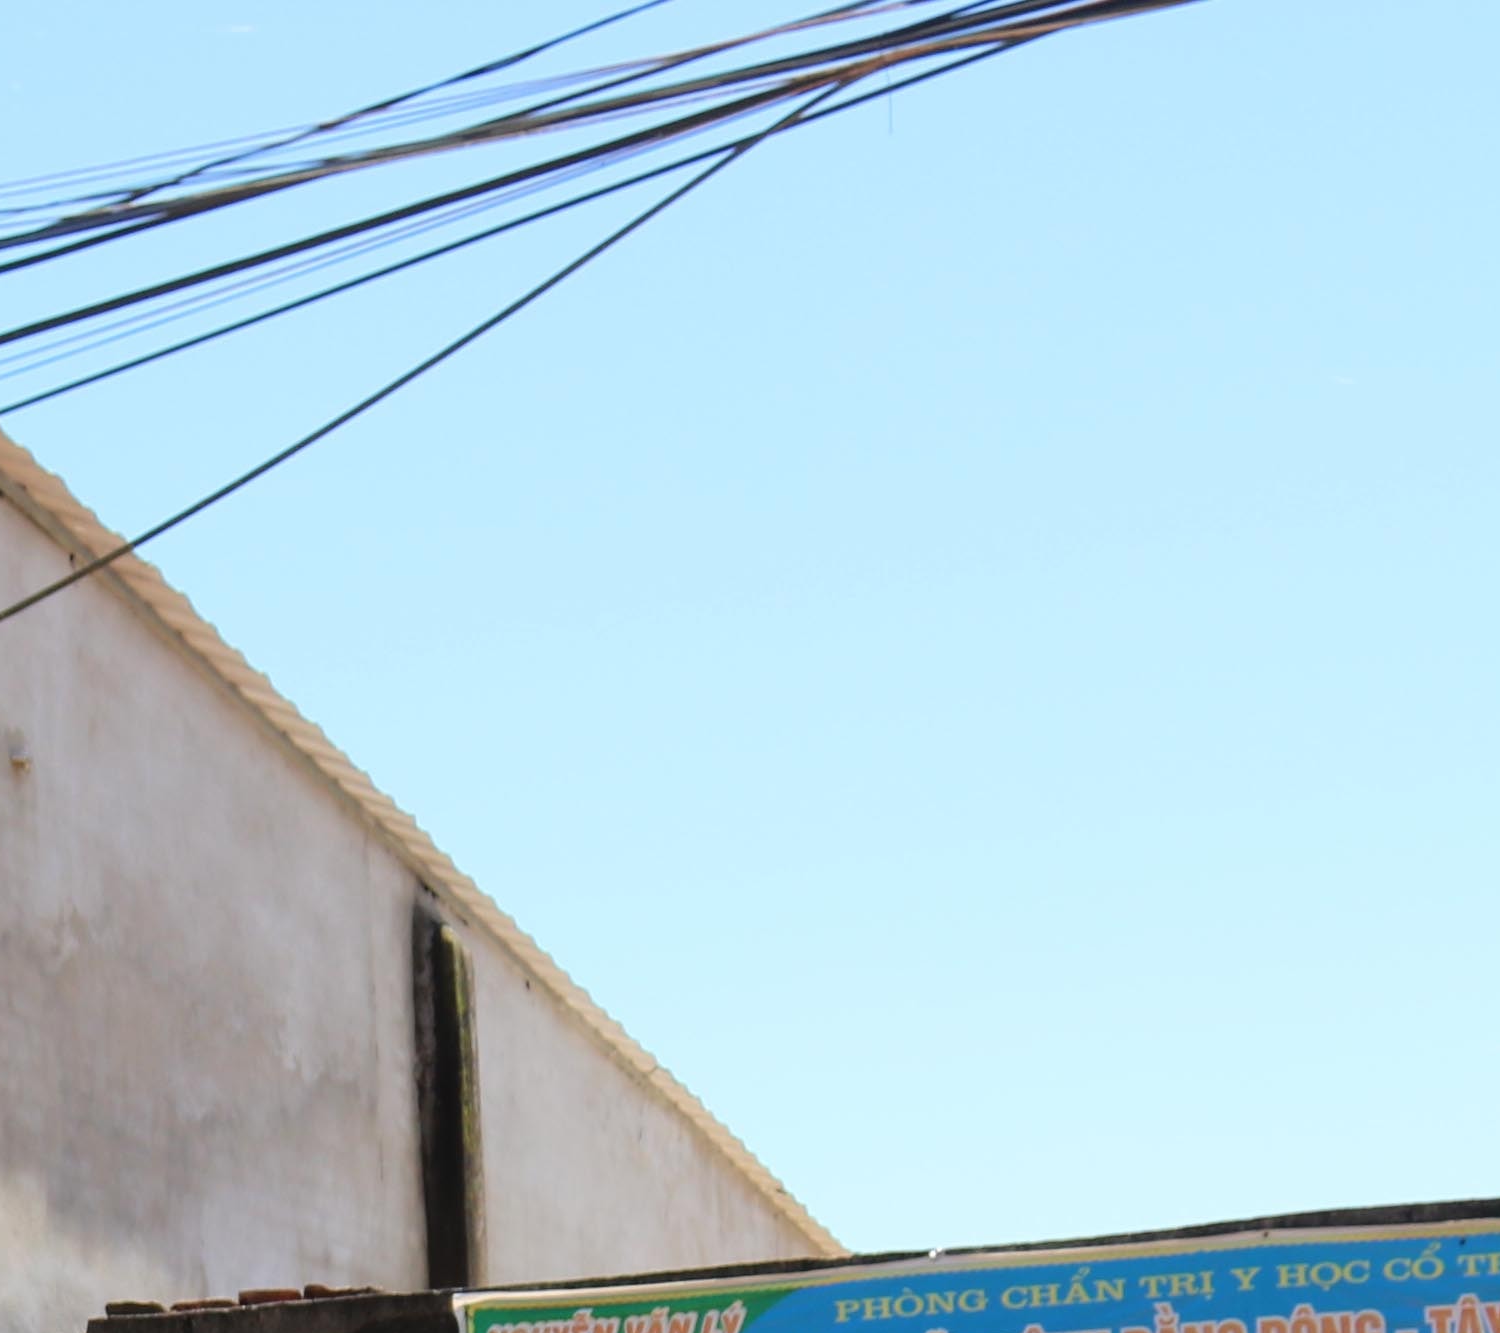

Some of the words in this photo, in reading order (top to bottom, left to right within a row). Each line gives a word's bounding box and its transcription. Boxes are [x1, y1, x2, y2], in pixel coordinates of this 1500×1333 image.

[835, 1287, 988, 1323] PHÒNG
[1002, 1267, 1125, 1309] CHẨN
[1140, 1271, 1214, 1302] TRỊ
[1231, 1267, 1261, 1291] Y
[1276, 1261, 1371, 1292] HỌC
[1384, 1242, 1444, 1281] CỔ
